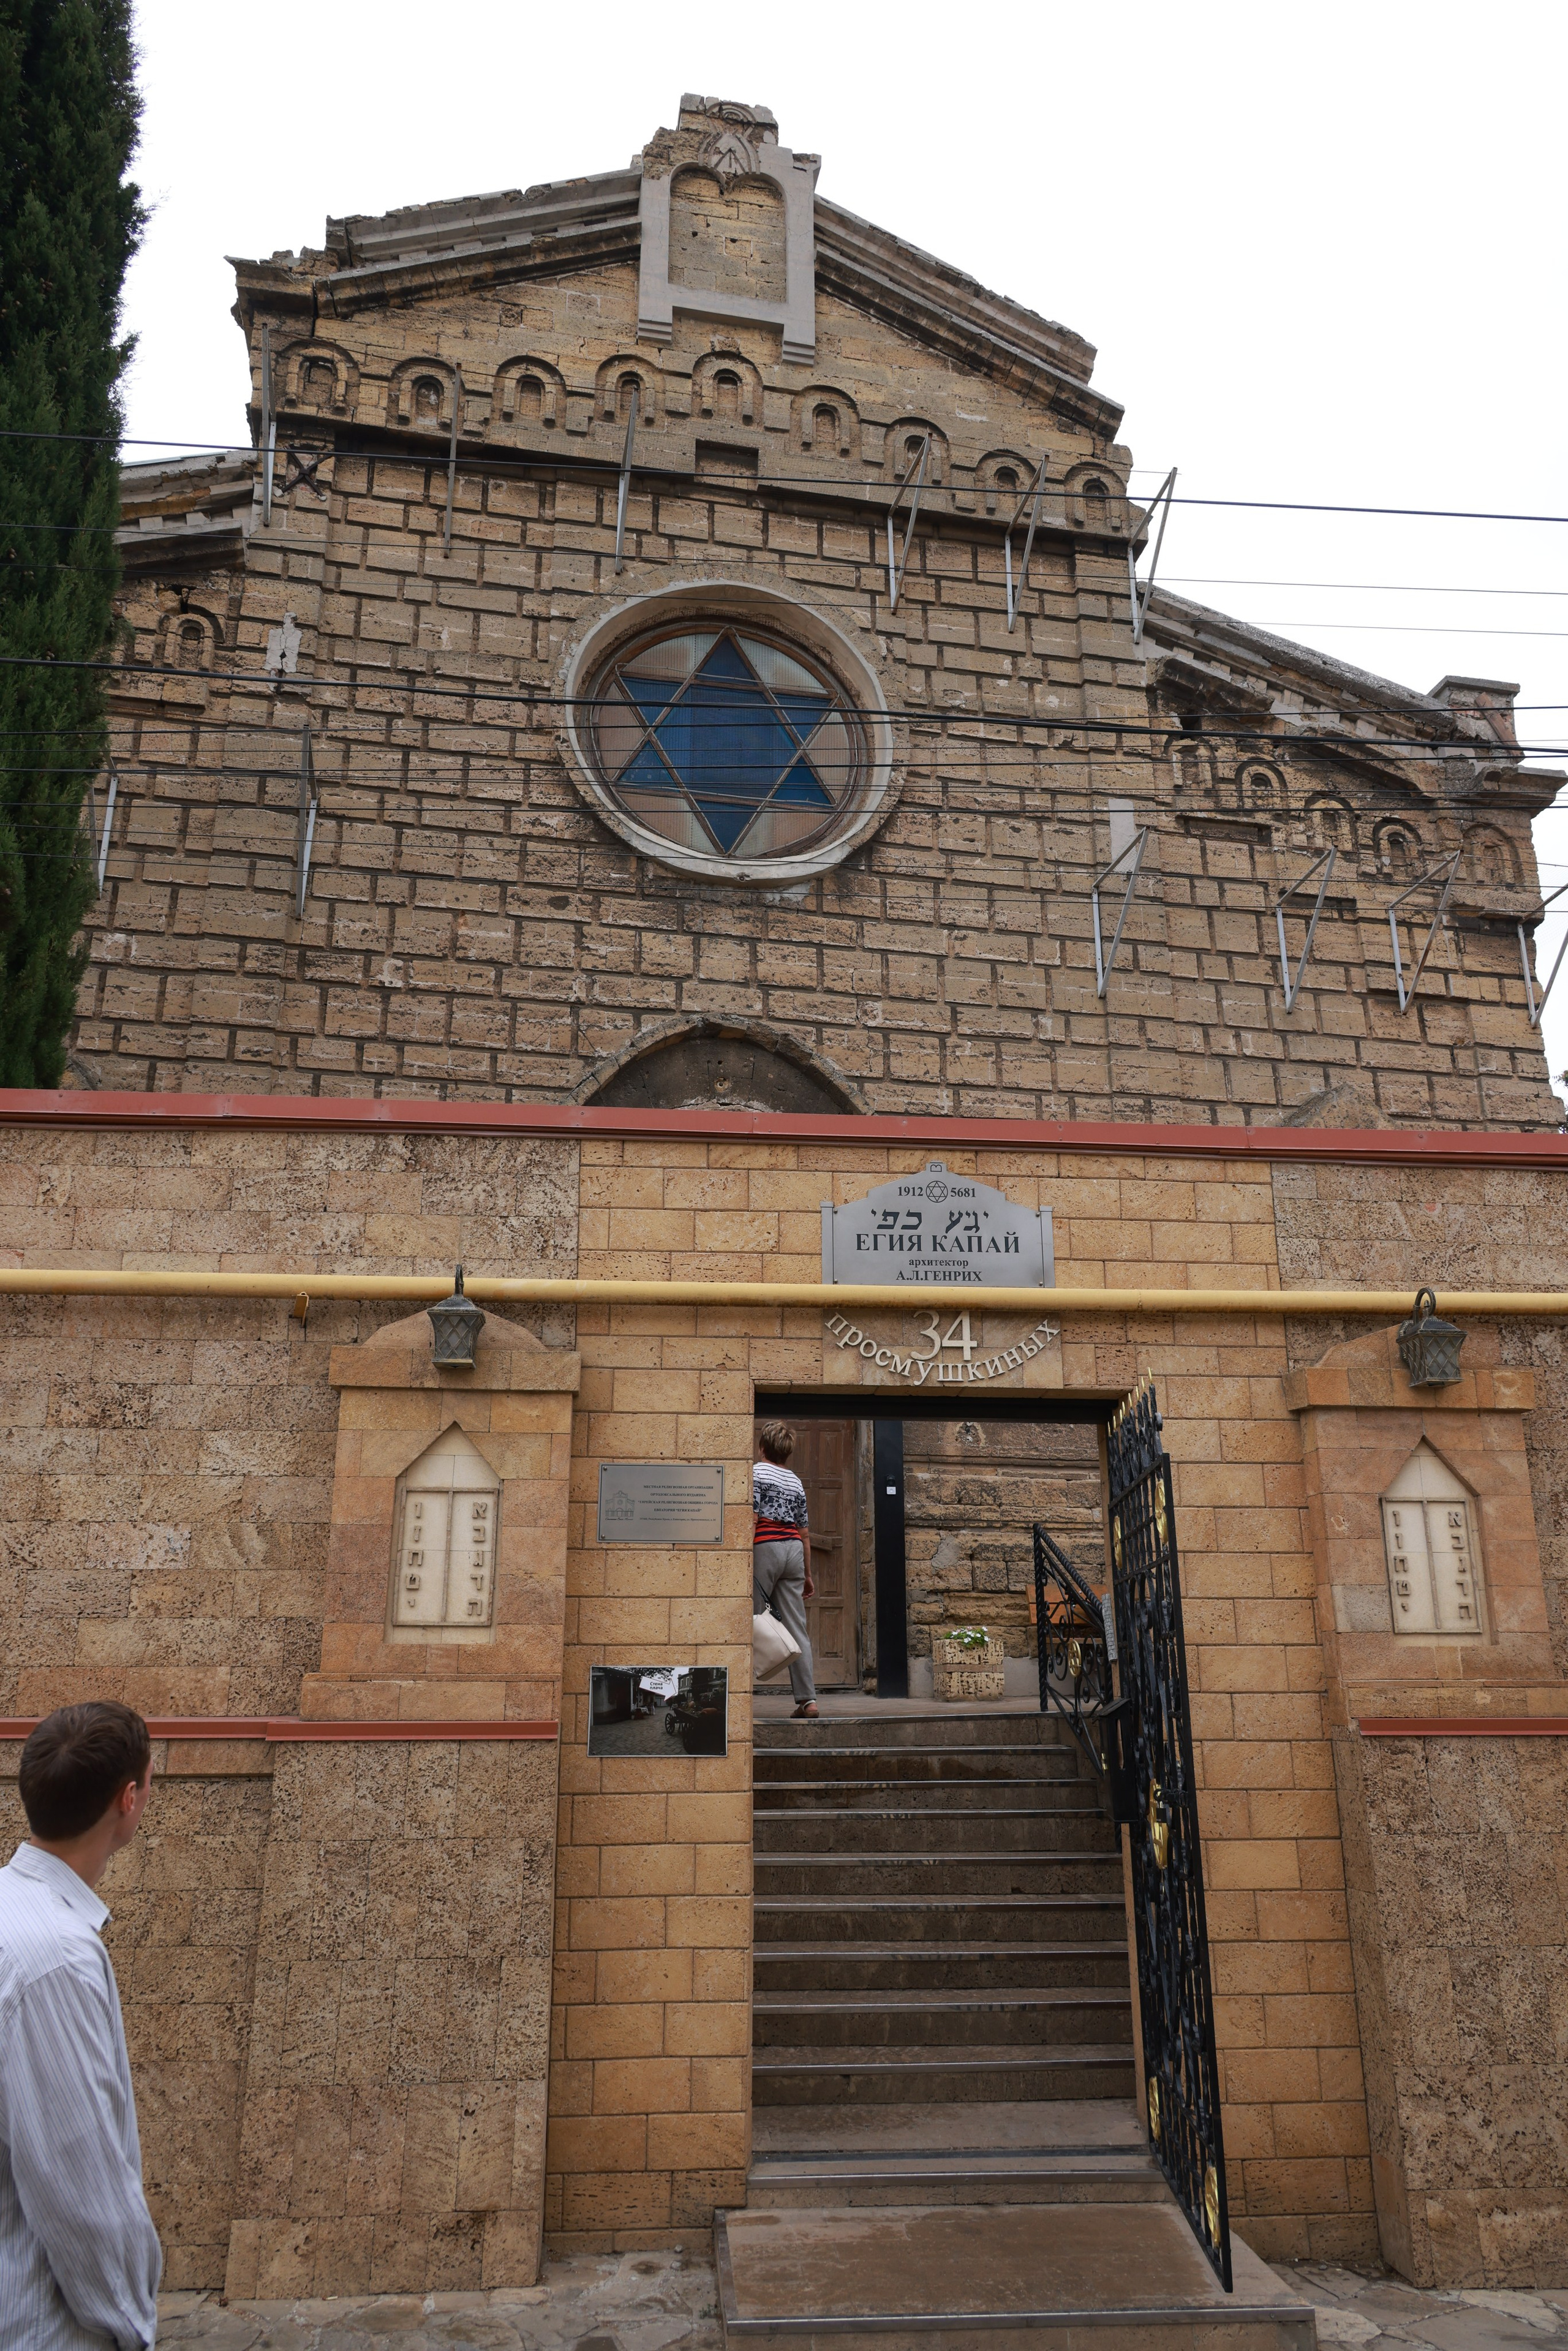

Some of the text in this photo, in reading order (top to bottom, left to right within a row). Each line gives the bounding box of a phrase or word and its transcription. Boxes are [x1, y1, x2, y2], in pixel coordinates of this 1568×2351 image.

[897, 1186, 976, 1198] 1912 5681
[856, 1231, 1020, 1253] ЕГИЯ КАПАЙ
[908, 1259, 969, 1269] архитектор
[895, 1270, 983, 1282] А.Л.ГЕНРИХ
[910, 1310, 978, 1361] 34
